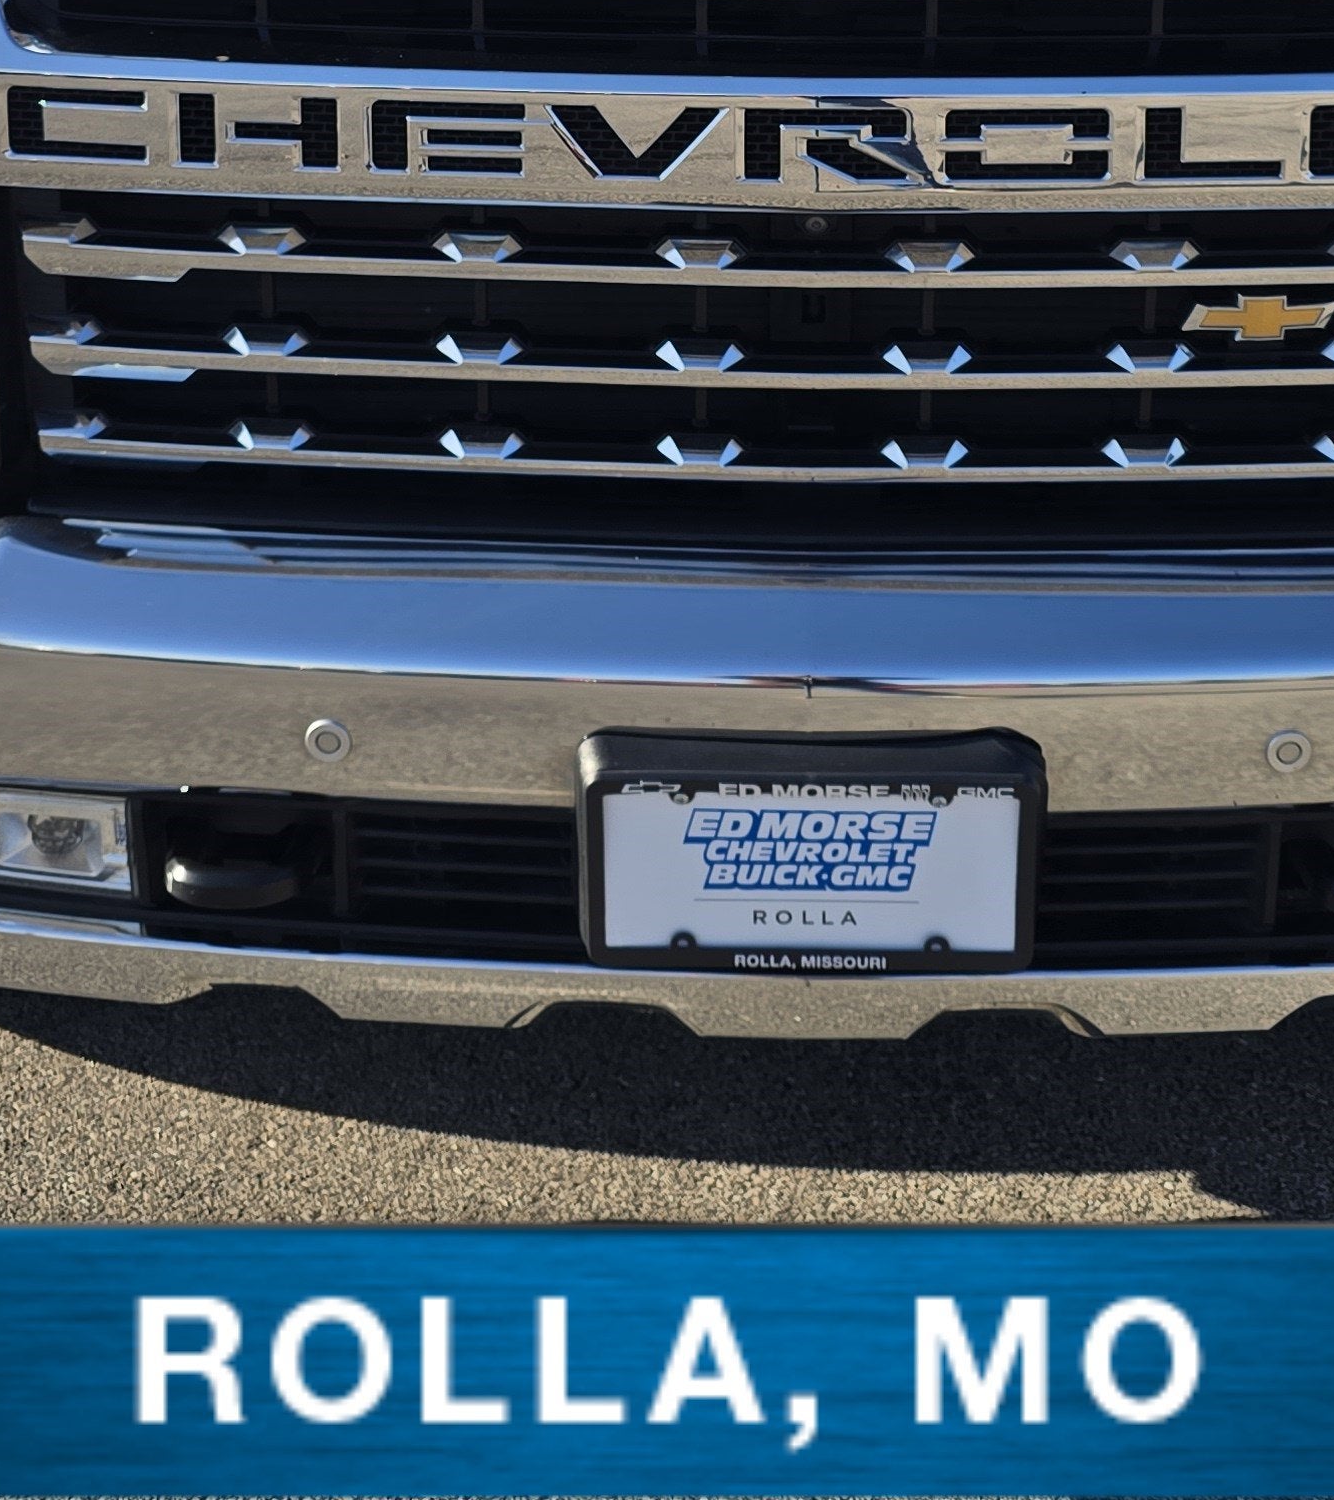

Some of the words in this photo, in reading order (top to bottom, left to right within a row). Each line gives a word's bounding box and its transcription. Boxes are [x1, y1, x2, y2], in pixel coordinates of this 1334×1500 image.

[687, 811, 754, 839] ED
[756, 812, 933, 842] MORSE
[705, 839, 915, 864] CHEVROLET
[752, 909, 858, 926] ROLLA
[733, 953, 797, 970] ROLLA,
[800, 954, 887, 970] MISSOURI
